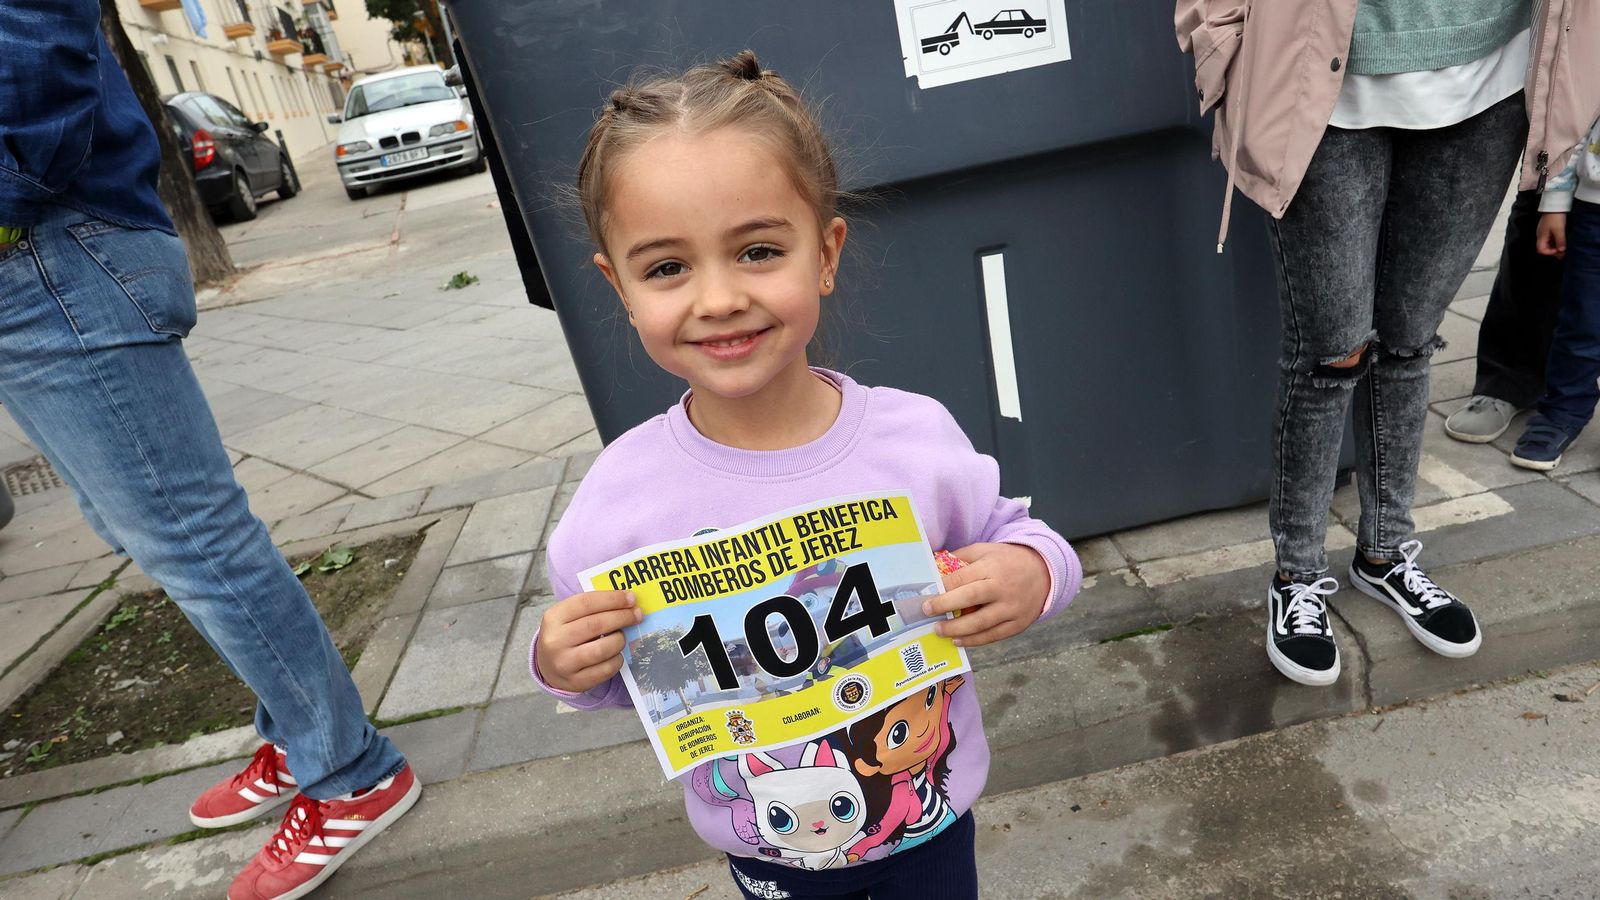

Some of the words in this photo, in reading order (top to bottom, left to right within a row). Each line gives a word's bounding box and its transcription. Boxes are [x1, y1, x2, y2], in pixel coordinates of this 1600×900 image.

[608, 548, 700, 591] CARRERA
[698, 522, 793, 569] INFANTIL
[792, 499, 898, 538] BENEFICA
[659, 559, 766, 604] BOMBEROS
[766, 546, 797, 577] DE
[800, 527, 862, 565] JEREZ
[677, 561, 896, 691] 104
[895, 670, 927, 688] Ayuntamiento
[676, 716, 705, 731] ORGANIZA:
[782, 706, 822, 725] COLABORAN:
[677, 725, 711, 743] AGRUPACIÓN
[680, 745, 688, 753] DE
[687, 733, 717, 750] BOMBEROS
[690, 750, 699, 759] DE
[698, 744, 715, 757] JEREZ
